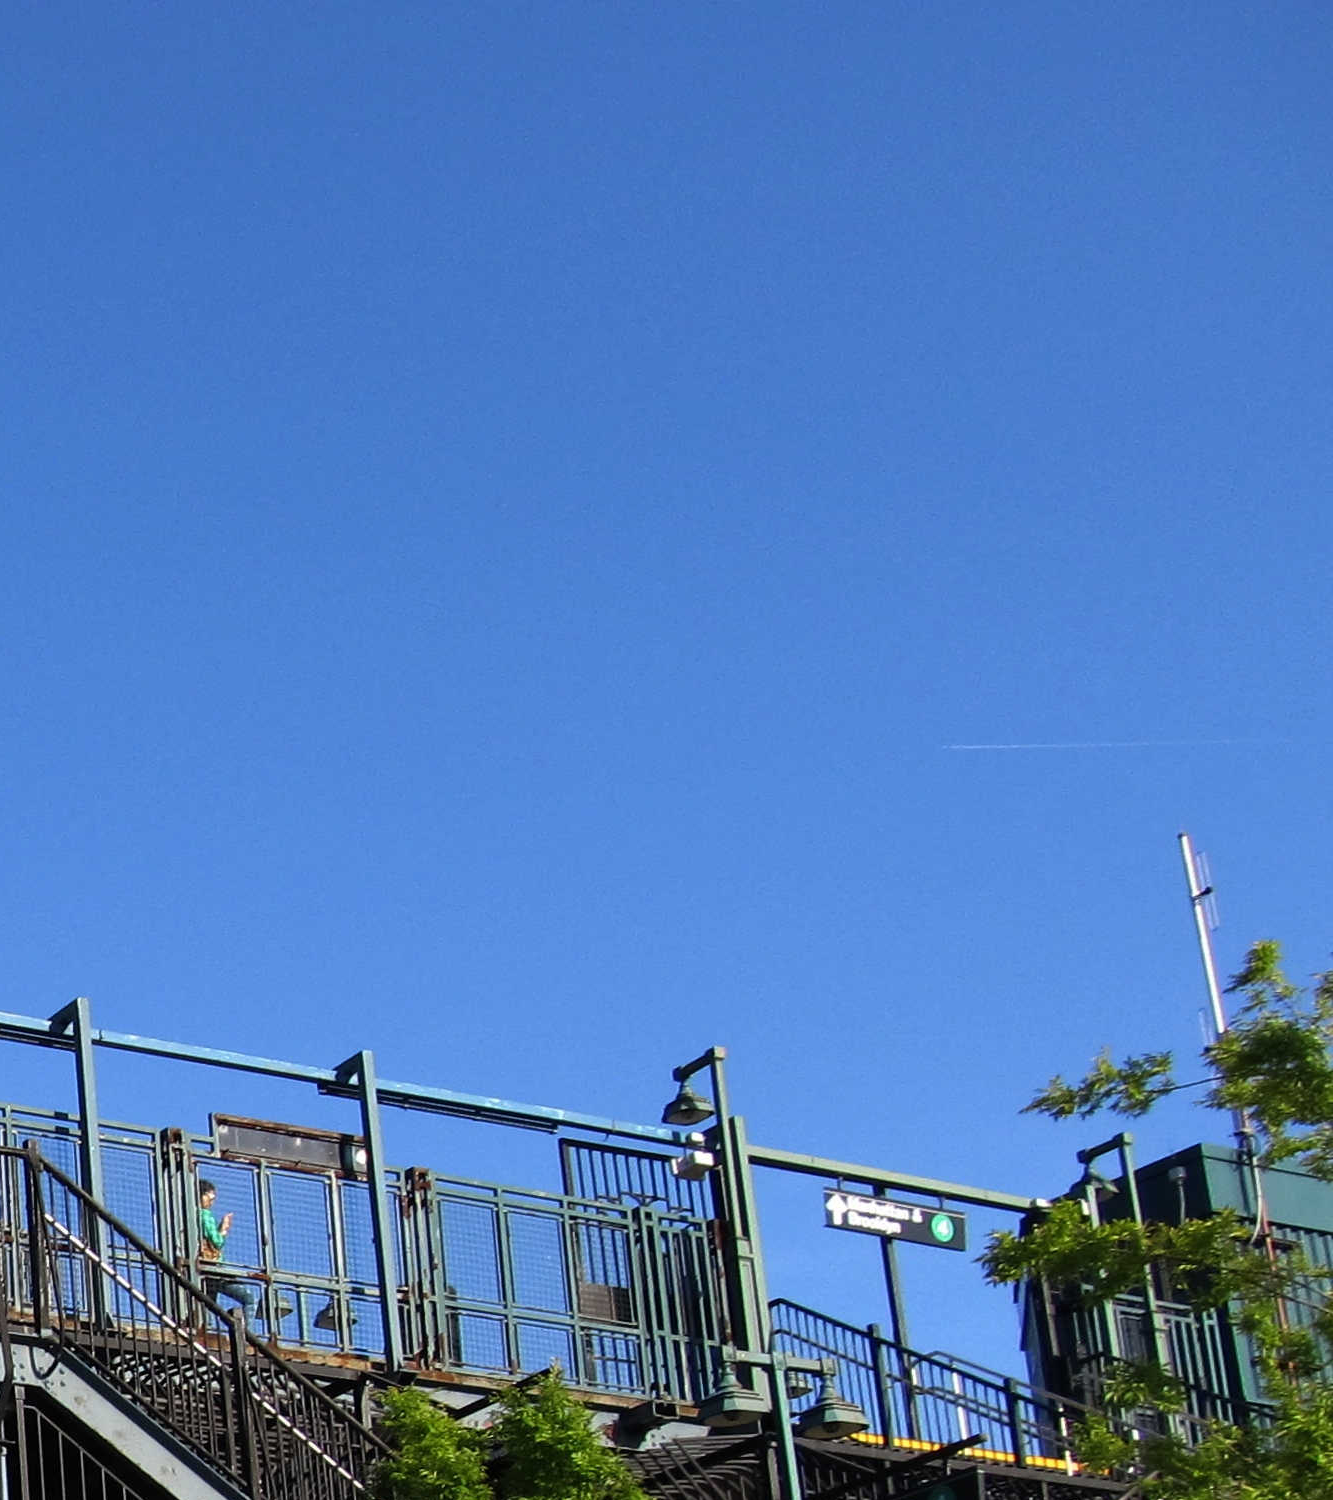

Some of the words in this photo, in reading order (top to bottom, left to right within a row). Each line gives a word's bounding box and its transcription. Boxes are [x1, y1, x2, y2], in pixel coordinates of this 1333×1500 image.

[846, 1195, 910, 1221] Manhattan
[847, 1210, 902, 1235] Brooklyn
[936, 1220, 950, 1235] 4
